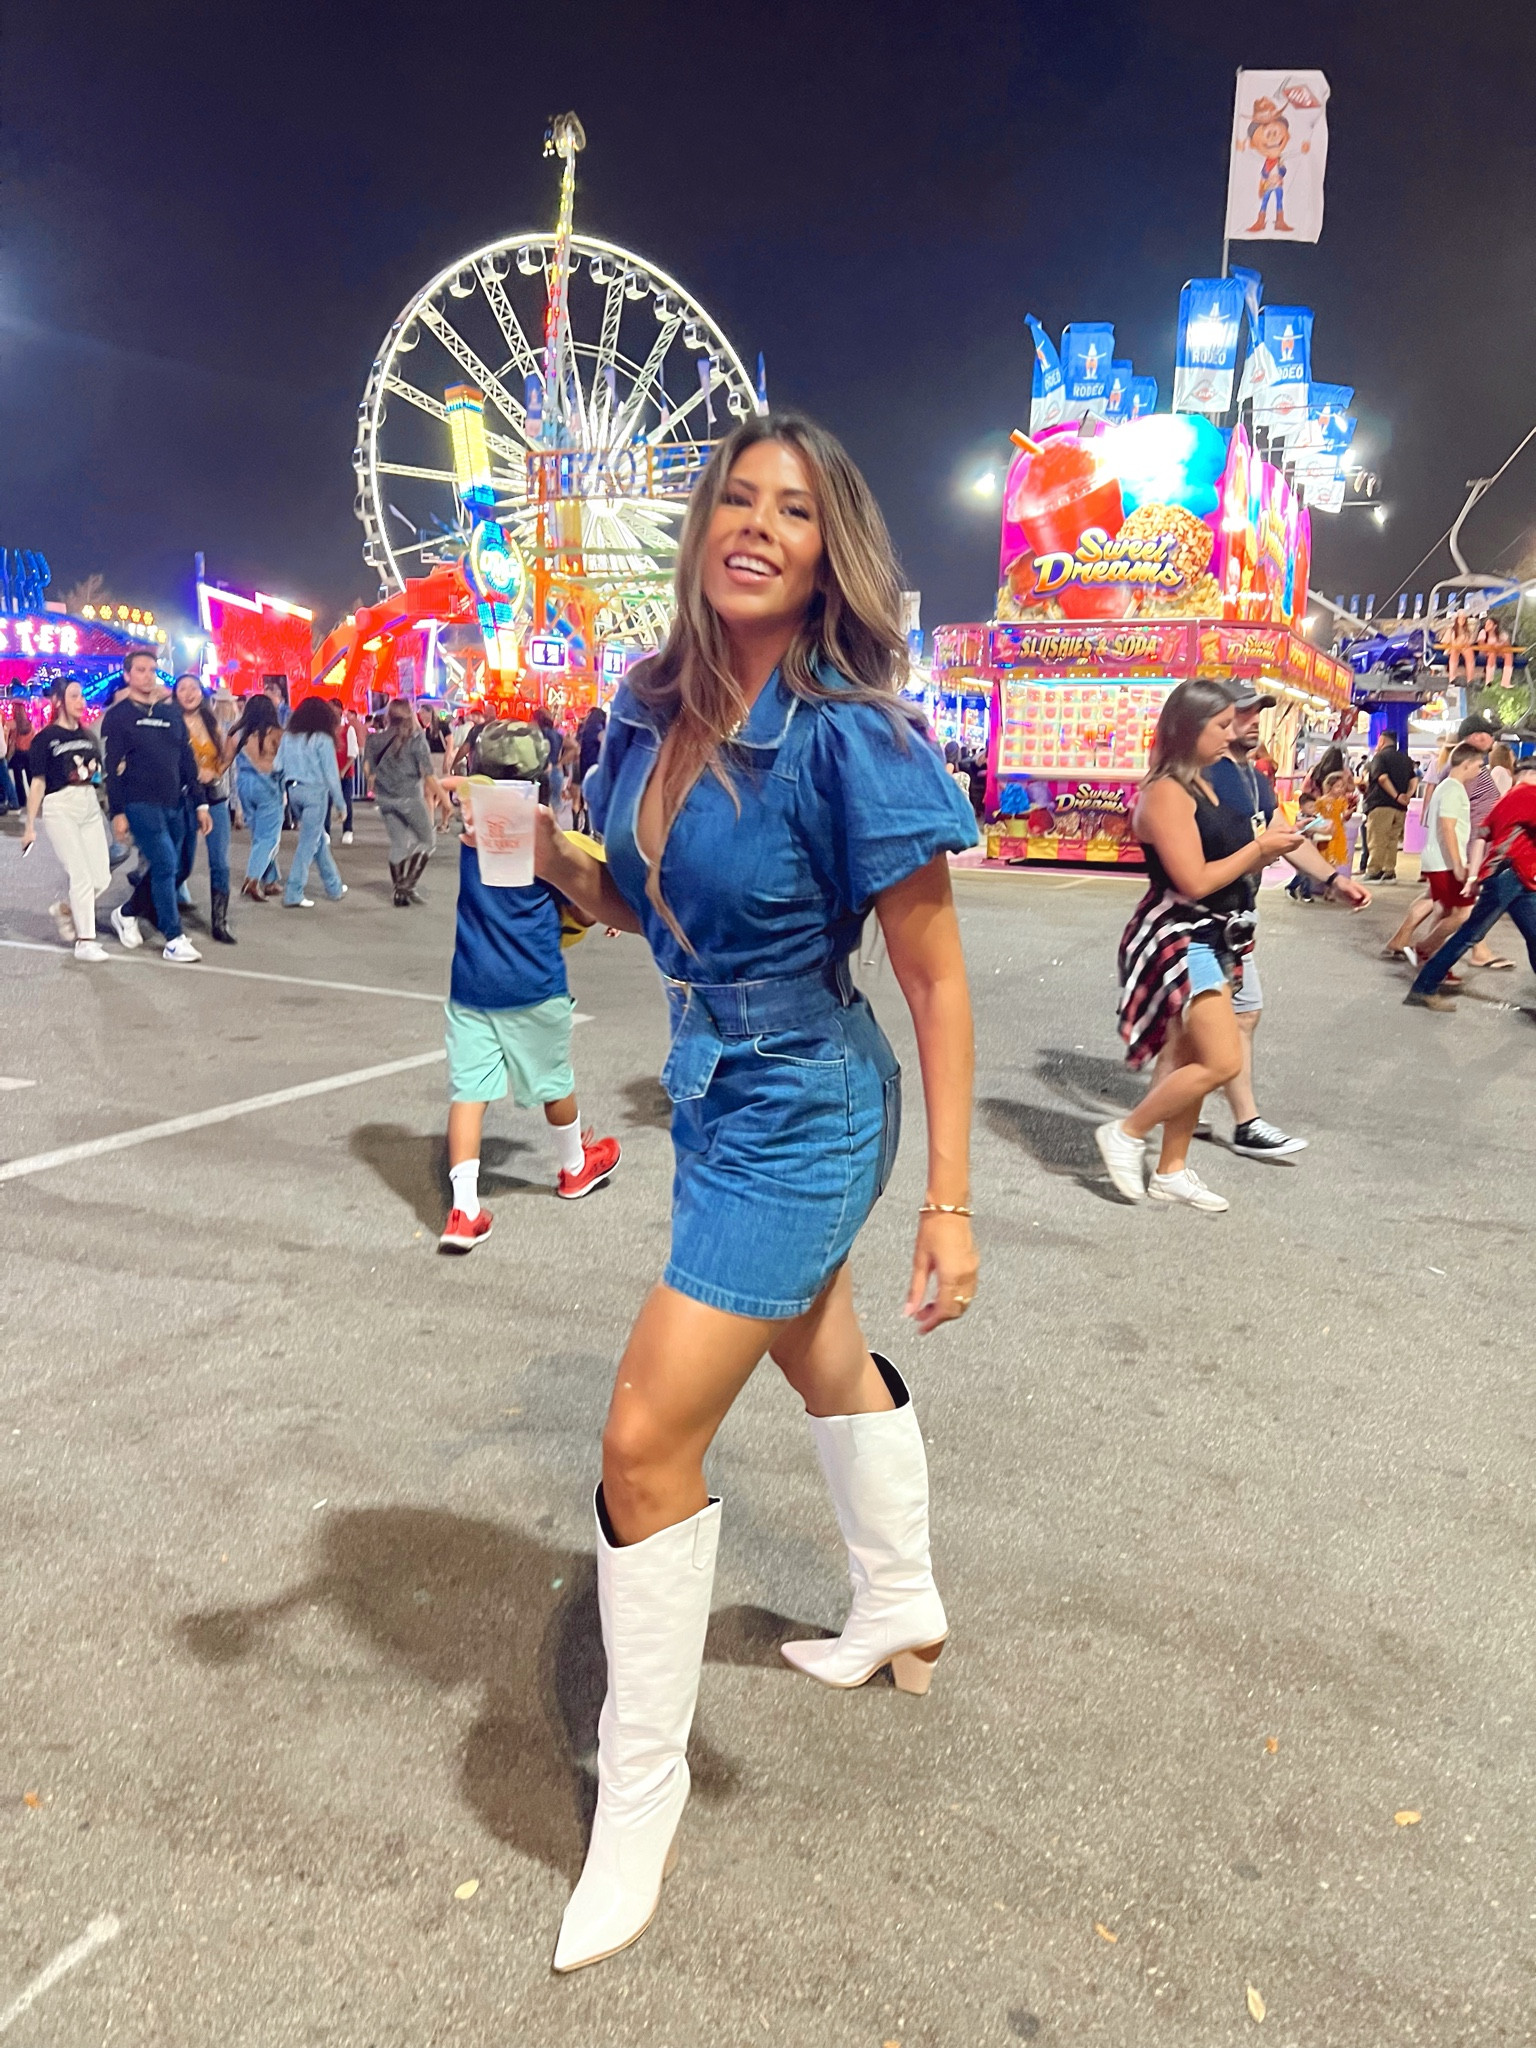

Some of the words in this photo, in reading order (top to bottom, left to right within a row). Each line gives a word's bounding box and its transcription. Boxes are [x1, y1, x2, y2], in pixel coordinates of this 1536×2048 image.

[1072, 382, 1105, 397] RODEO
[1075, 527, 1177, 562] Sweet
[1033, 552, 1184, 592] Dreams
[1019, 635, 1093, 659] SLUSHIES
[1095, 636, 1109, 659] &
[1113, 634, 1158, 659] SODA
[1244, 634, 1275, 650] Sweet
[1226, 643, 1277, 662] Dreams
[1076, 783, 1124, 801] Sweet
[1054, 793, 1128, 814] Dreams
